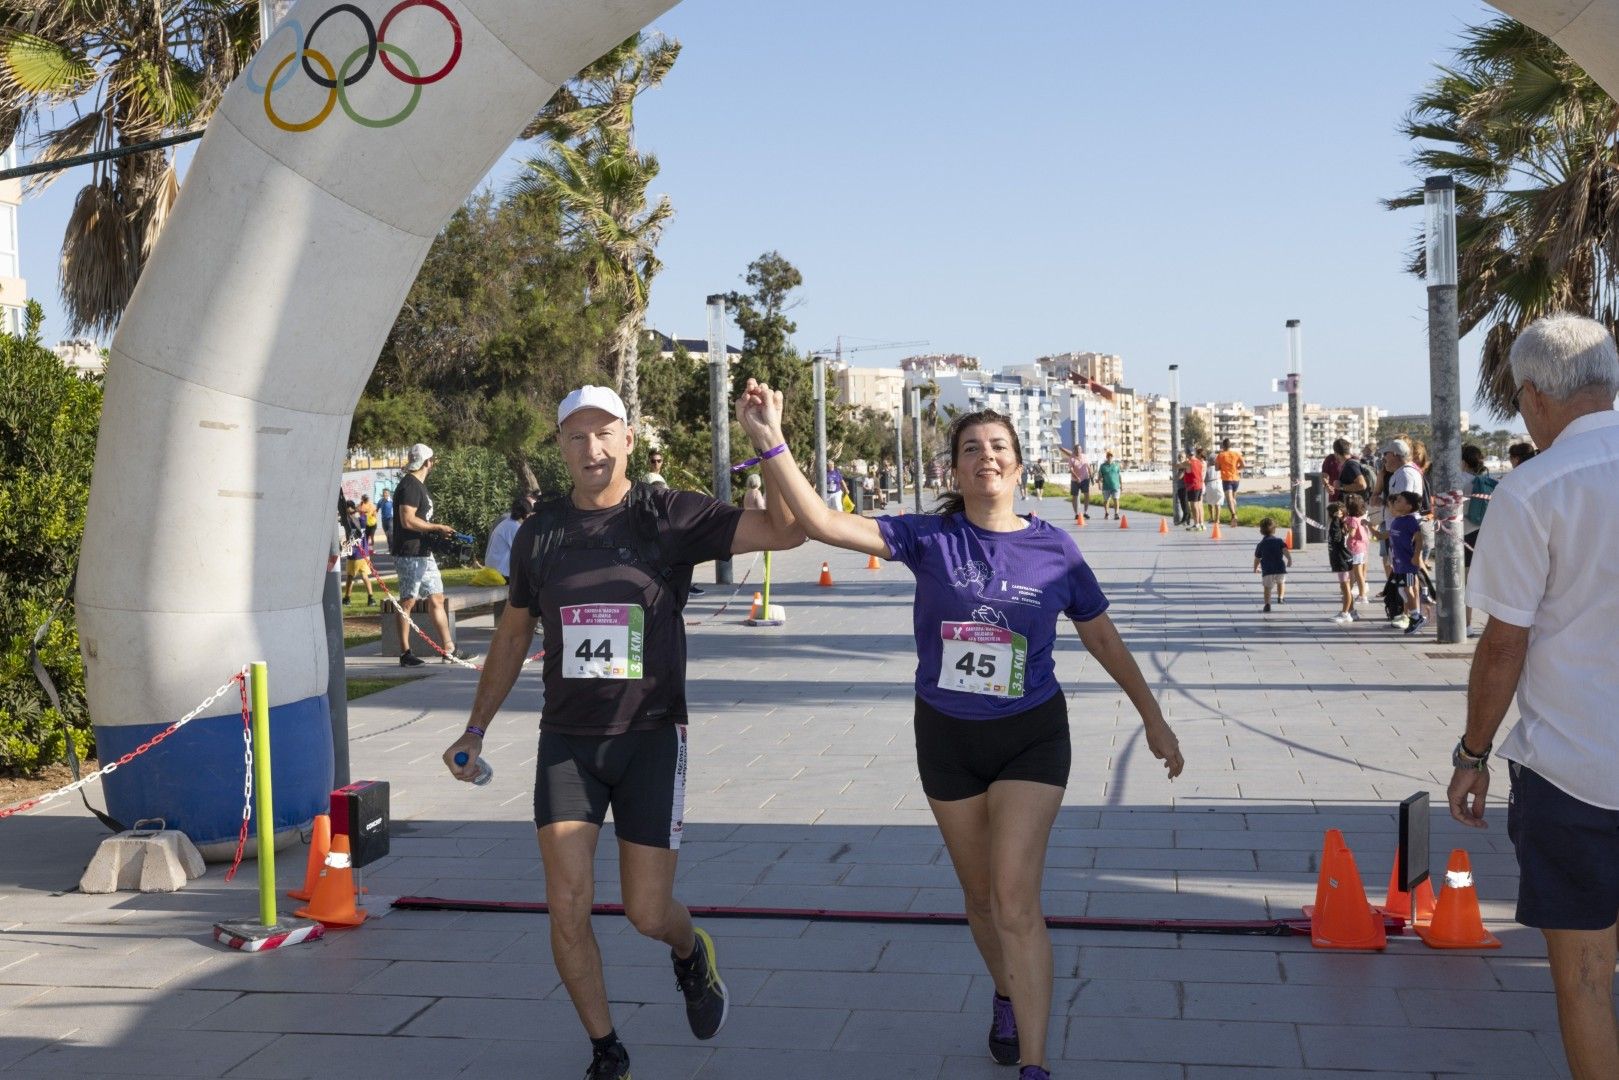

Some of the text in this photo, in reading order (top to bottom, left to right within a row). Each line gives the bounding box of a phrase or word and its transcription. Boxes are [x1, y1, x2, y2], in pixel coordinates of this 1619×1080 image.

[575, 639, 613, 662] 44
[631, 631, 641, 652] KM
[955, 651, 997, 678] 45
[1014, 649, 1025, 670] KM
